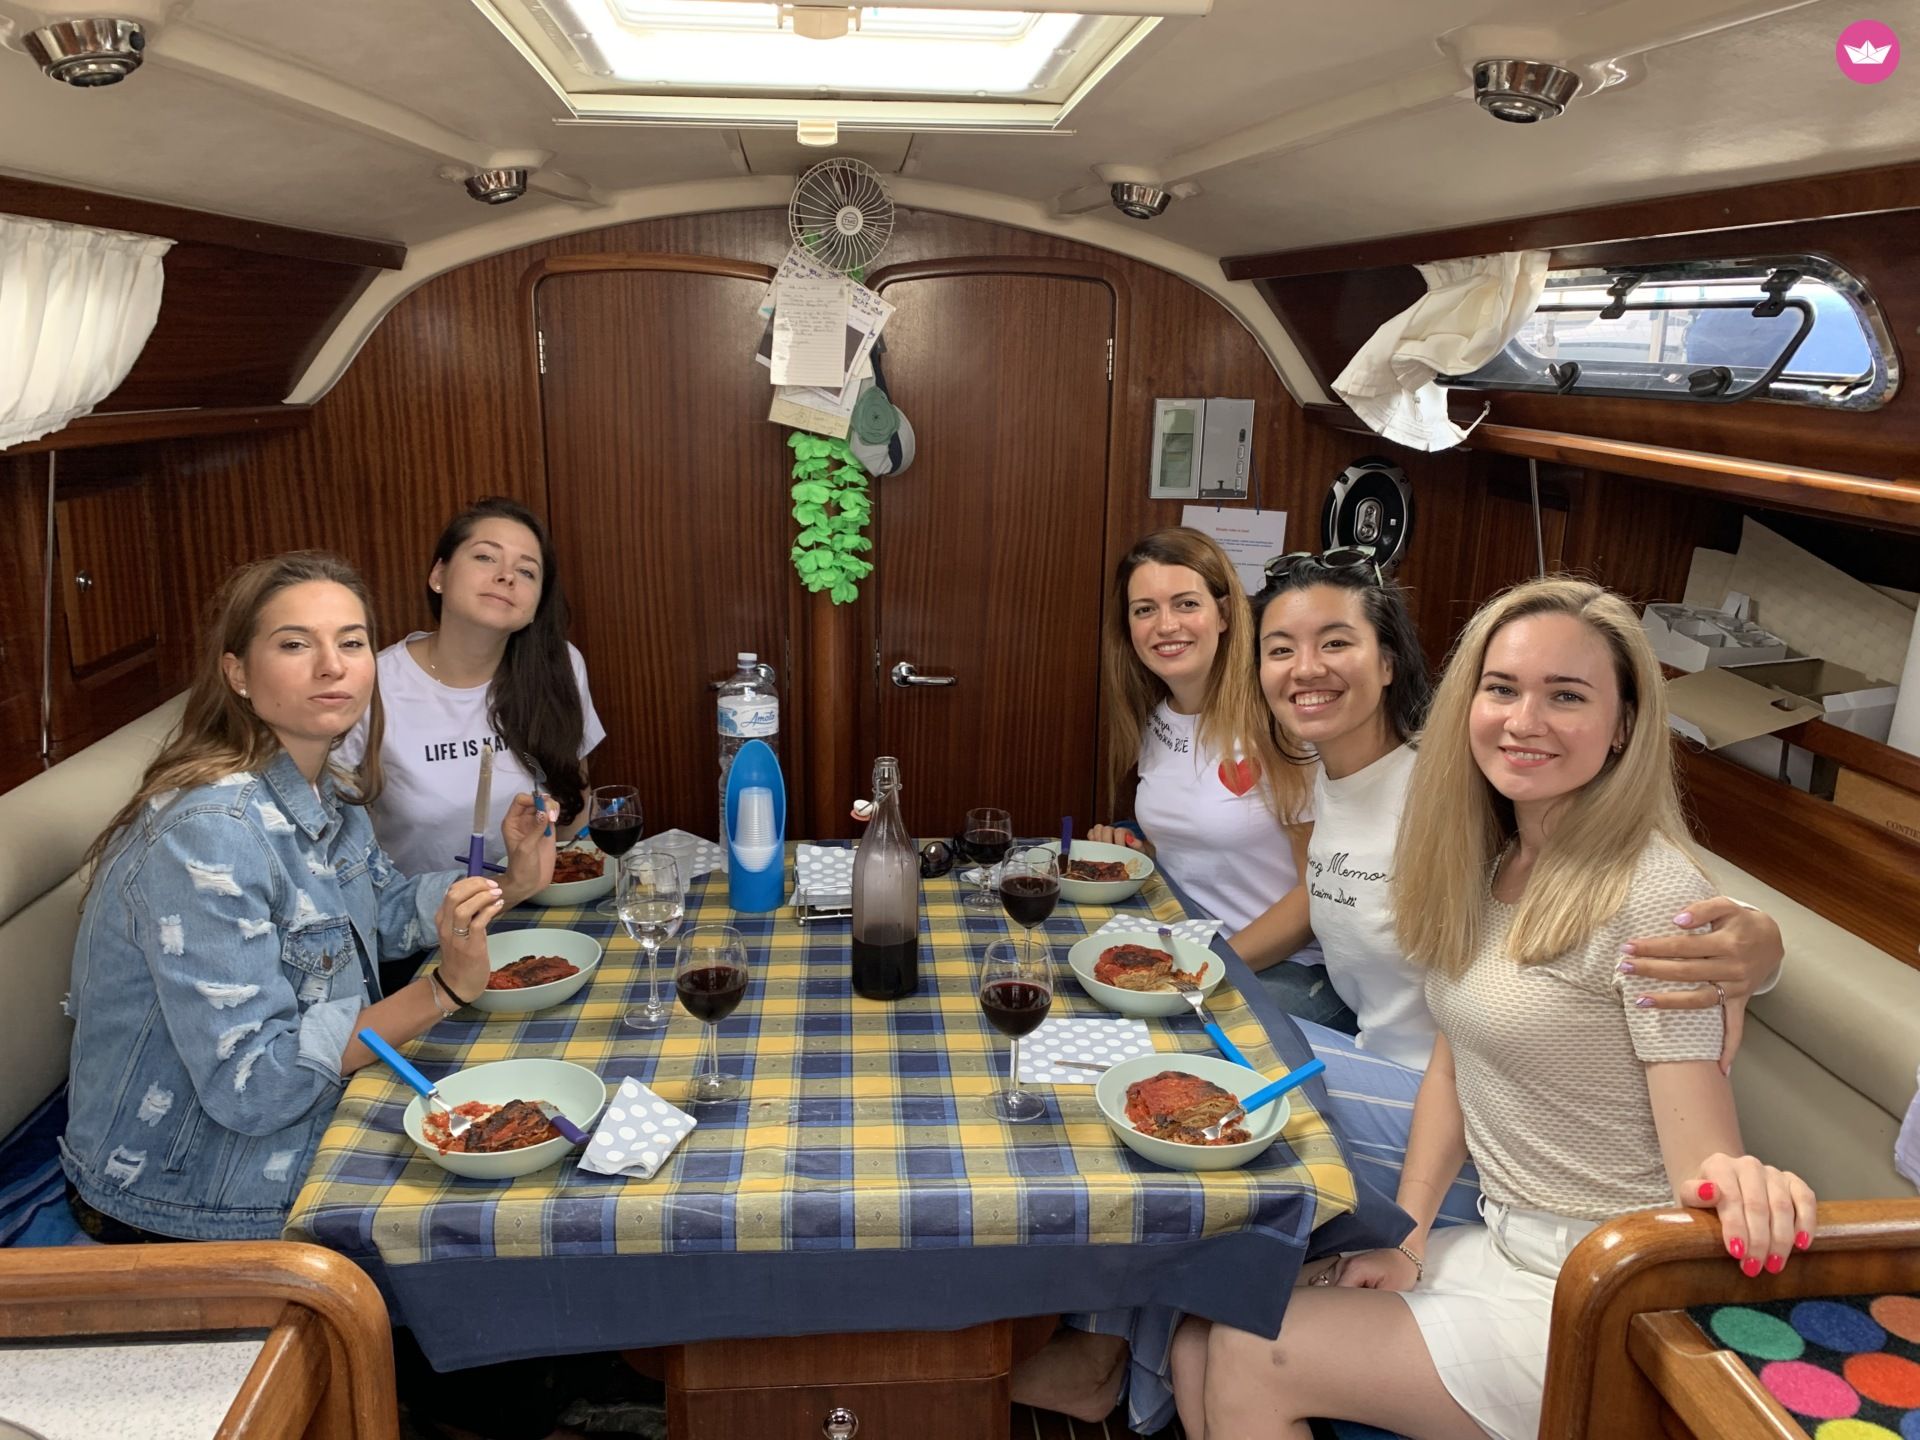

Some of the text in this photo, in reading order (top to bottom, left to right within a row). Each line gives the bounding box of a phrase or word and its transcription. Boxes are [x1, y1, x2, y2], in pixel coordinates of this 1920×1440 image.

[425, 735, 509, 761] LIFE IS KA
